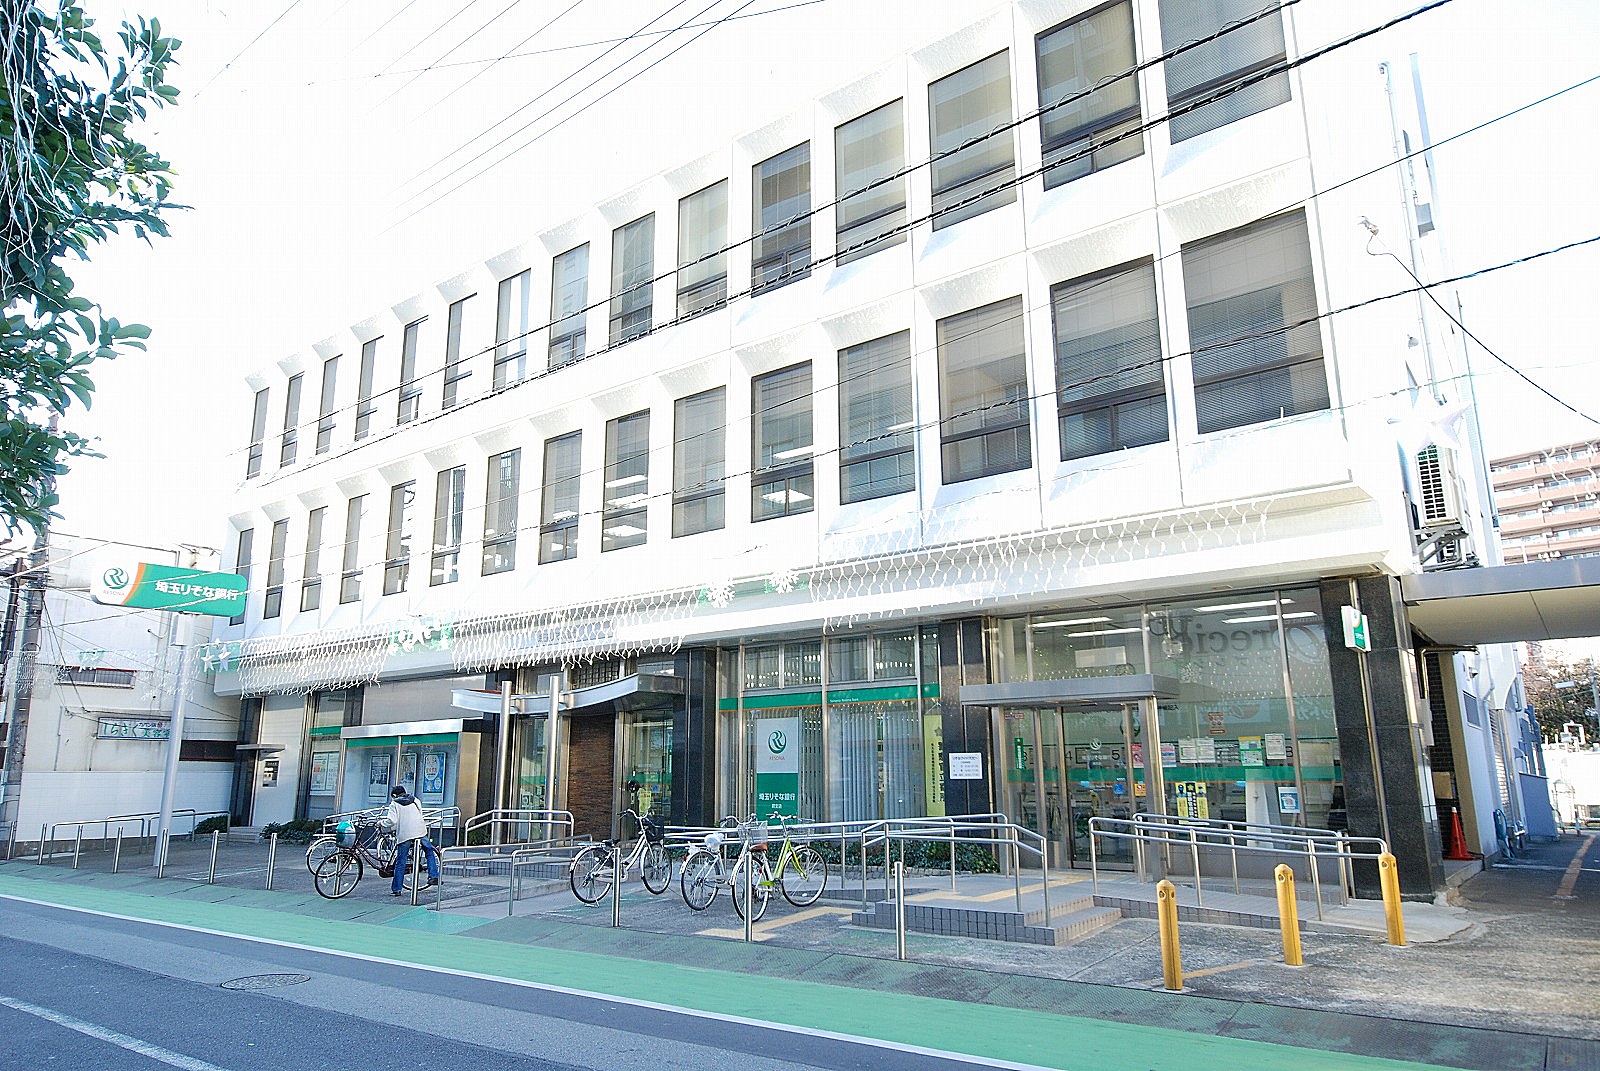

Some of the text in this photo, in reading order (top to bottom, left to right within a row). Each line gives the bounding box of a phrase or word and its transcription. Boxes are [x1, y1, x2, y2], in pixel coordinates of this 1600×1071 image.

[155, 581, 239, 601] 埼玉りそな銀行
[1111, 749, 1121, 760] 5
[759, 793, 795, 801] 埼玉りそな銀行
